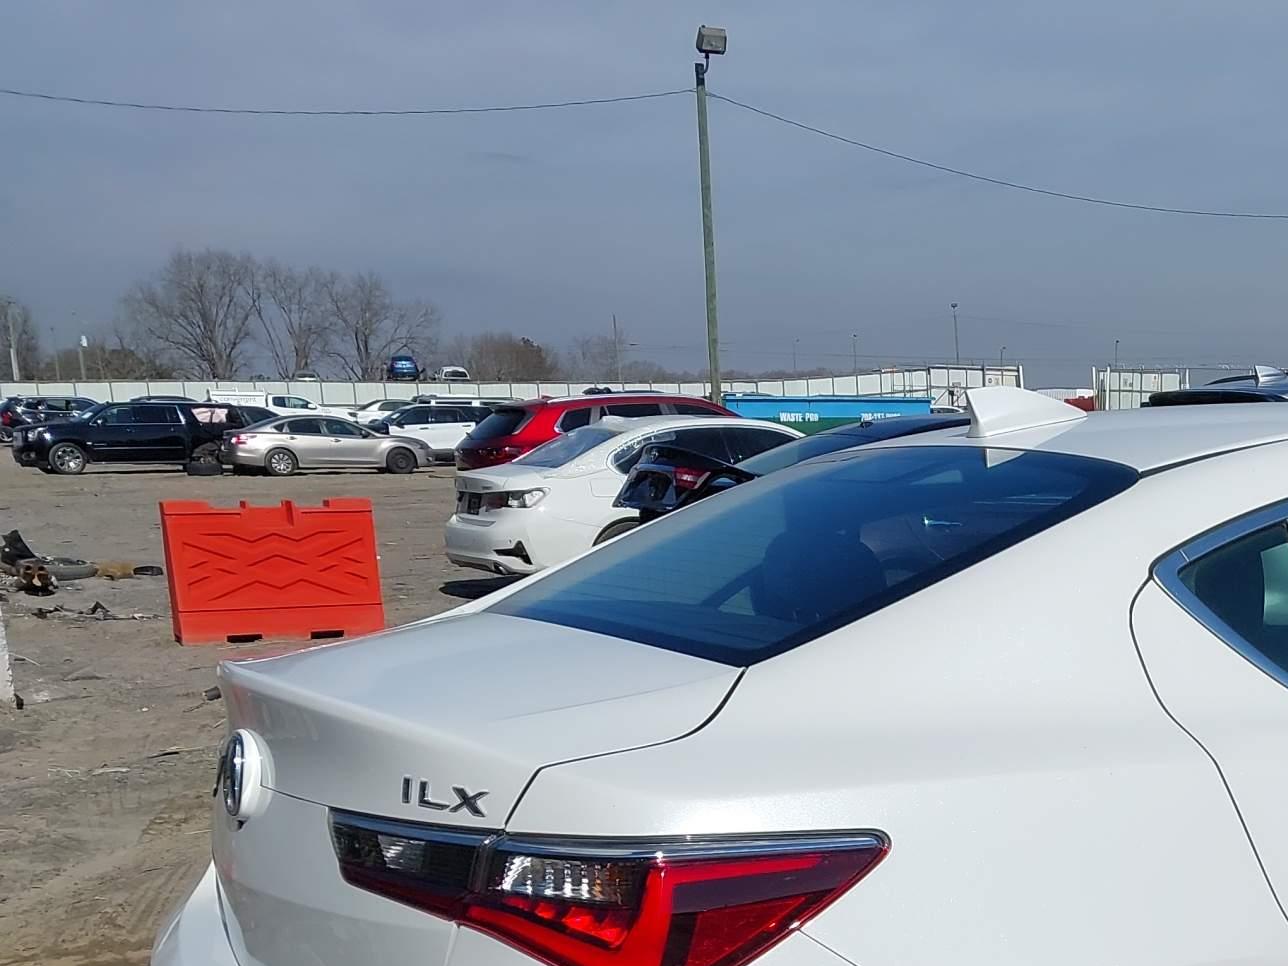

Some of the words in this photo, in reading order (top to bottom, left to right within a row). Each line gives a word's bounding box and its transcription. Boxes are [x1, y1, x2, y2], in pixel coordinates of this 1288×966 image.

[779, 412, 803, 422] WASTE
[805, 412, 819, 422] PRO
[402, 777, 490, 817] ILX
